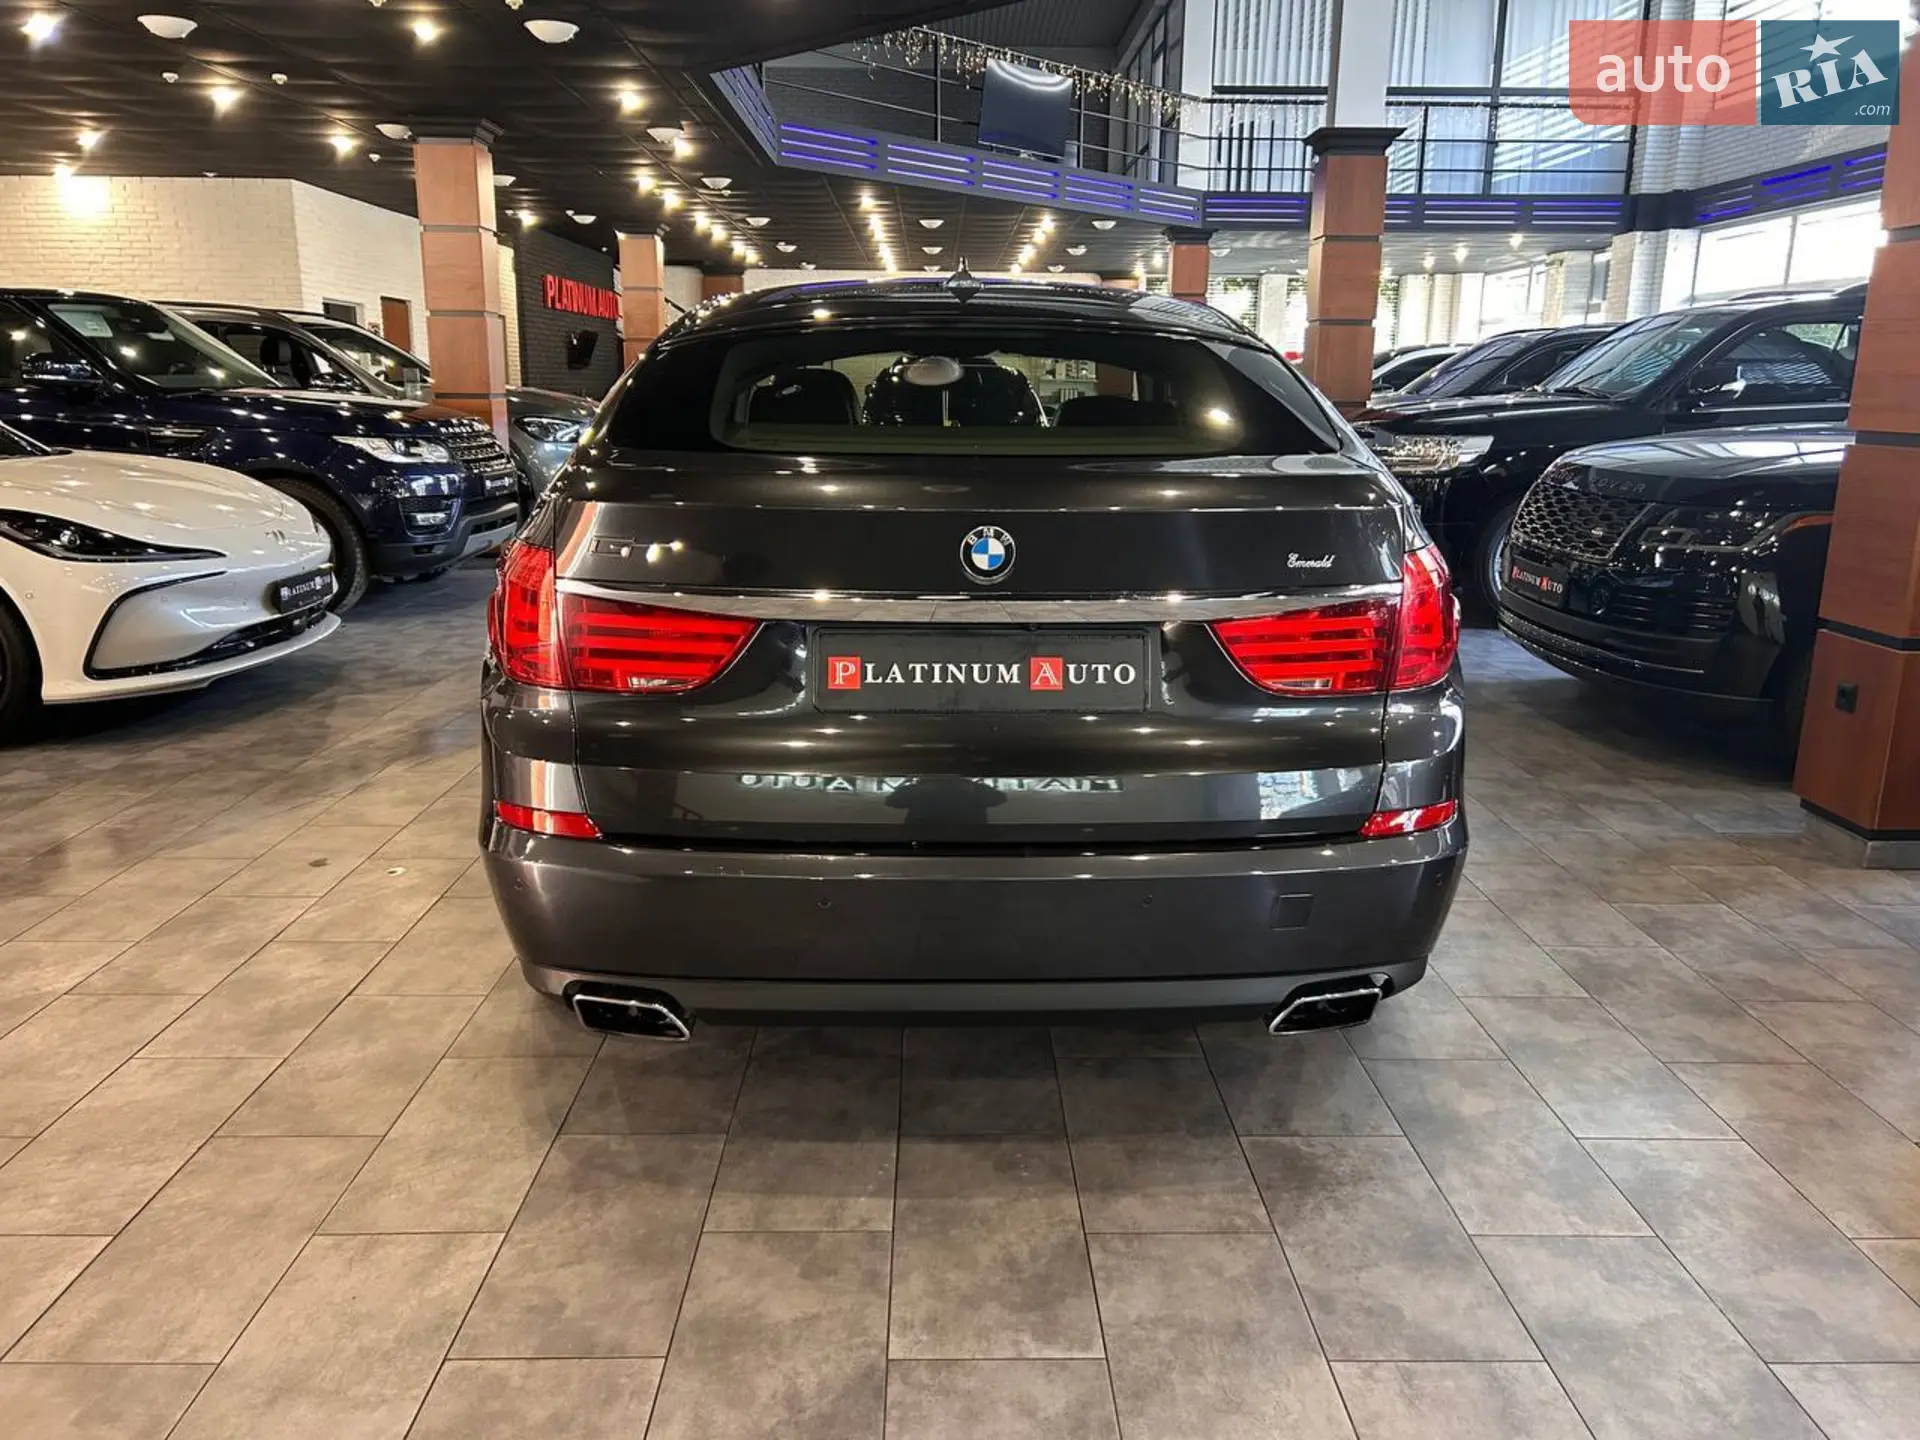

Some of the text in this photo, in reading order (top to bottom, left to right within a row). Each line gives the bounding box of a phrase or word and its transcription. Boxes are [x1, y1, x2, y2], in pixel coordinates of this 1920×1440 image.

[543, 274, 598, 316] PLATINUM
[966, 527, 1012, 546] BMW
[1287, 552, 1335, 568] Emerald
[1540, 576, 1563, 594] AUTO
[830, 659, 1136, 687] PLATINUM AUTO
